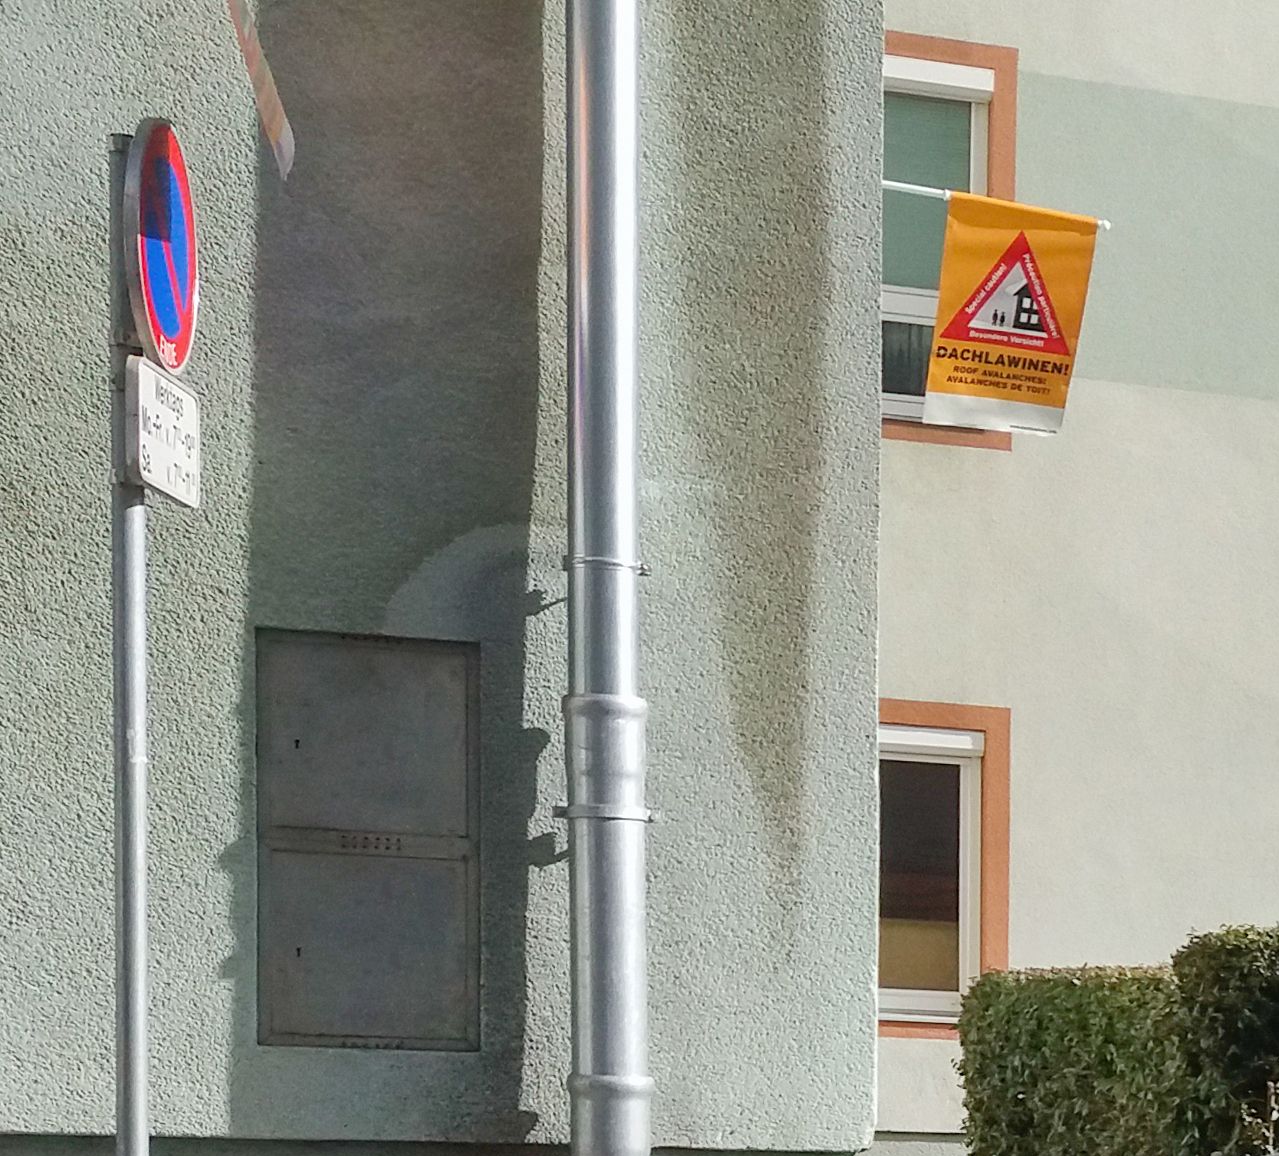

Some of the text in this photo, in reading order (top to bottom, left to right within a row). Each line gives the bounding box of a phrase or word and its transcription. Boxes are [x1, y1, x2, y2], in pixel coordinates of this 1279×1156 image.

[936, 345, 1070, 377] DACHLAWINEN!
[953, 364, 980, 375] ROOF
[946, 374, 1008, 390] AVALANCHES
